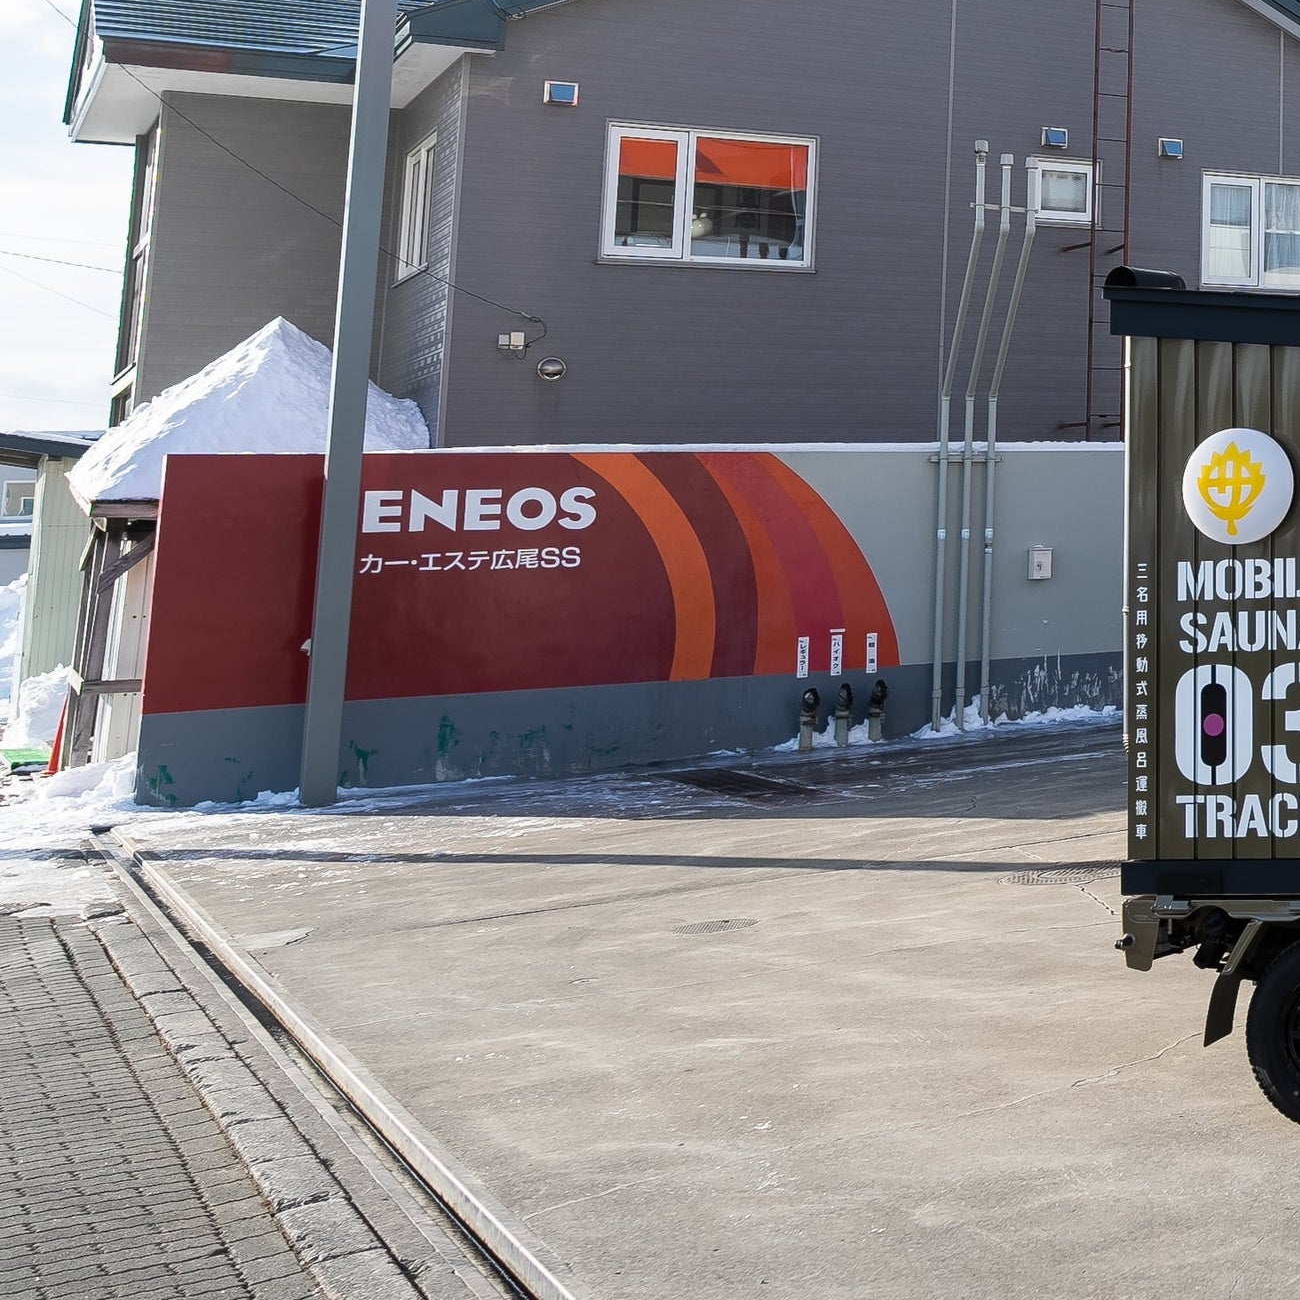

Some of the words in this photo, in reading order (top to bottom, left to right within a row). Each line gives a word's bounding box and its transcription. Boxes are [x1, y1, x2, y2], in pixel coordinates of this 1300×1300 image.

[362, 486, 597, 533] ENEOS
[359, 546, 582, 574] カー・エステ広尾SS
[832, 642, 841, 669] ハイオク
